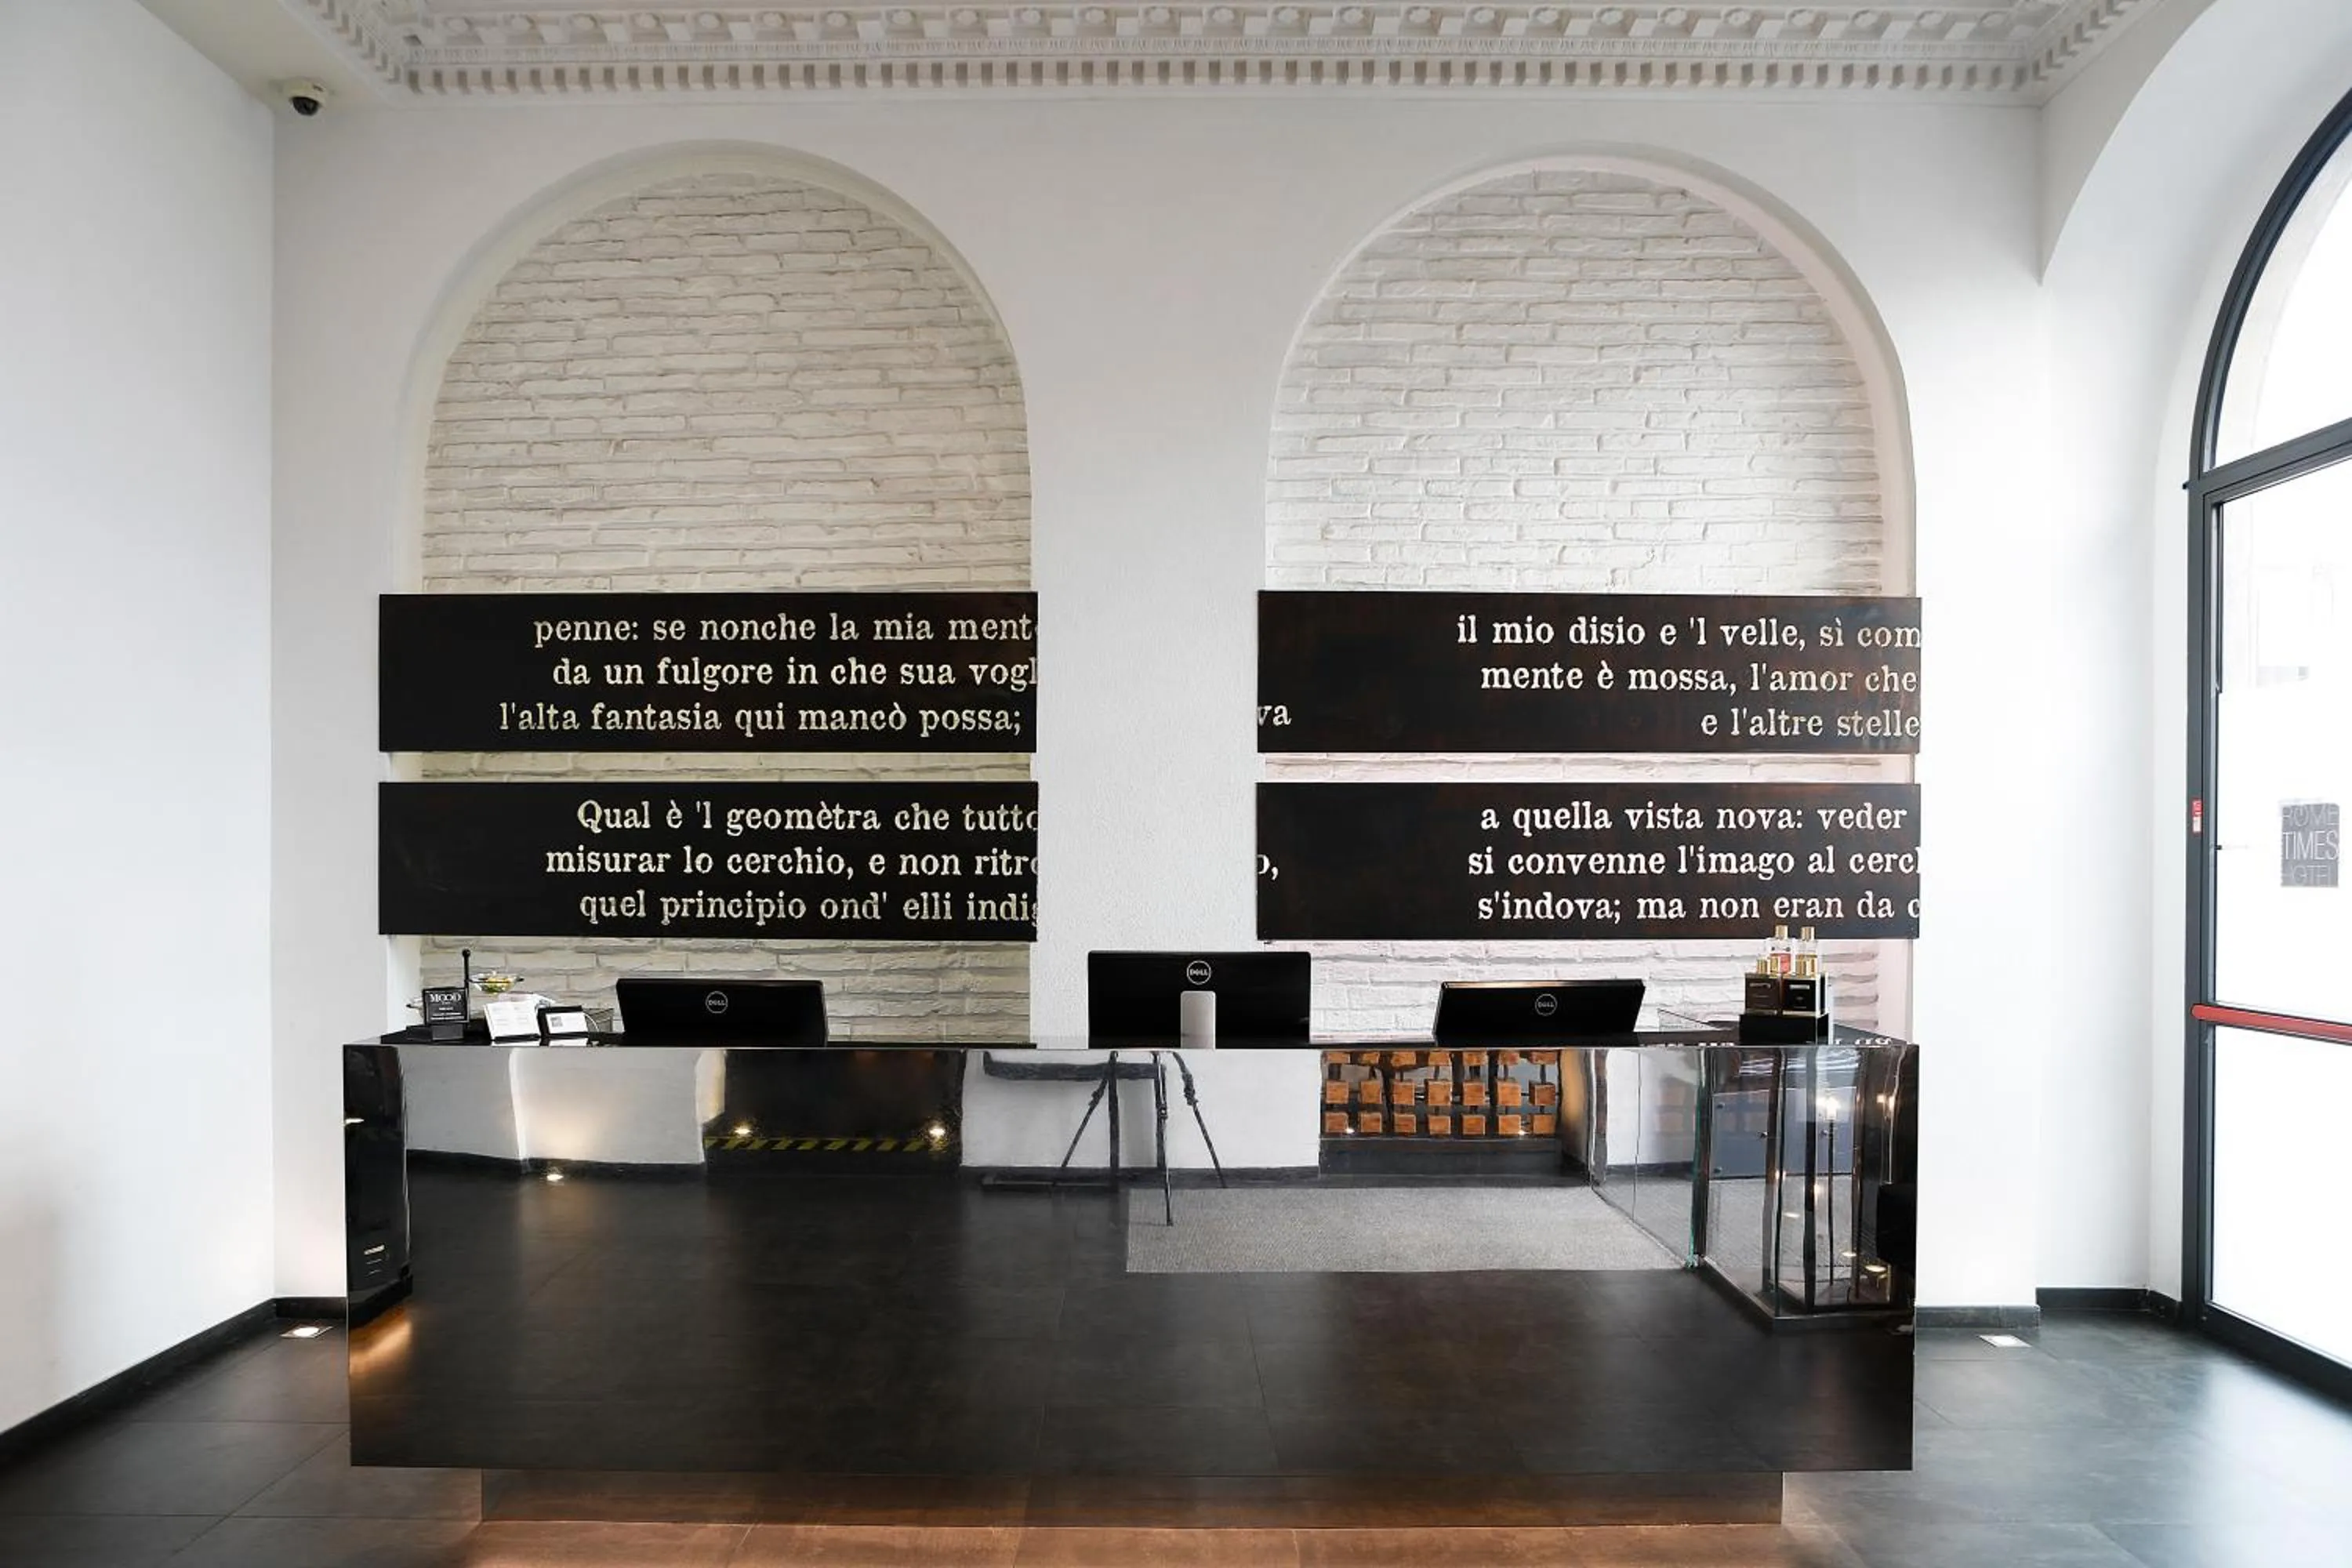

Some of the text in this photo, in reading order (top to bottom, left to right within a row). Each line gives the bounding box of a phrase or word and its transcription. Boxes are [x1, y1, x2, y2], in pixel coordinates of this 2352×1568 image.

[535, 612, 1037, 648] penne: se nonche la mia ment
[1457, 615, 1477, 643] il
[1493, 615, 1554, 644] mio
[1570, 616, 1645, 644] disio
[1660, 624, 1676, 645] e
[1690, 617, 1706, 644] 'l
[1719, 618, 1805, 652] velle,
[1820, 617, 1844, 647] sì
[554, 659, 590, 684] da
[604, 665, 644, 684] un
[658, 657, 772, 691] fulgore
[787, 657, 818, 684] in
[831, 657, 886, 684] che
[900, 663, 955, 684] sua
[1482, 660, 1917, 696] mente è mossa, l'amor che
[500, 702, 1020, 737] l'alta fantasia qui mancò possa;
[1701, 707, 1920, 736] e l'altre stelle
[578, 800, 650, 833] Qual
[666, 800, 682, 828] è
[696, 801, 712, 828] 'l
[728, 801, 880, 836] geomètra
[895, 803, 949, 830] che
[1481, 801, 1907, 835] a quella vista nova: veder
[546, 845, 671, 873] misurar
[684, 845, 713, 873] lo
[728, 847, 853, 880] cerchio,
[869, 855, 885, 875] e
[899, 855, 961, 875] non
[1468, 845, 1920, 880] si convenne l'imago al cerc
[2282, 830, 2339, 861] TIMES
[580, 890, 645, 924] quel
[660, 891, 806, 926] principio
[821, 892, 886, 919] ond'
[903, 892, 952, 919] elli
[1479, 891, 1620, 924] s'indova;
[1637, 898, 1686, 919] ma
[1700, 898, 1759, 919] non
[1773, 897, 1844, 918] eran
[1857, 891, 1895, 918] da
